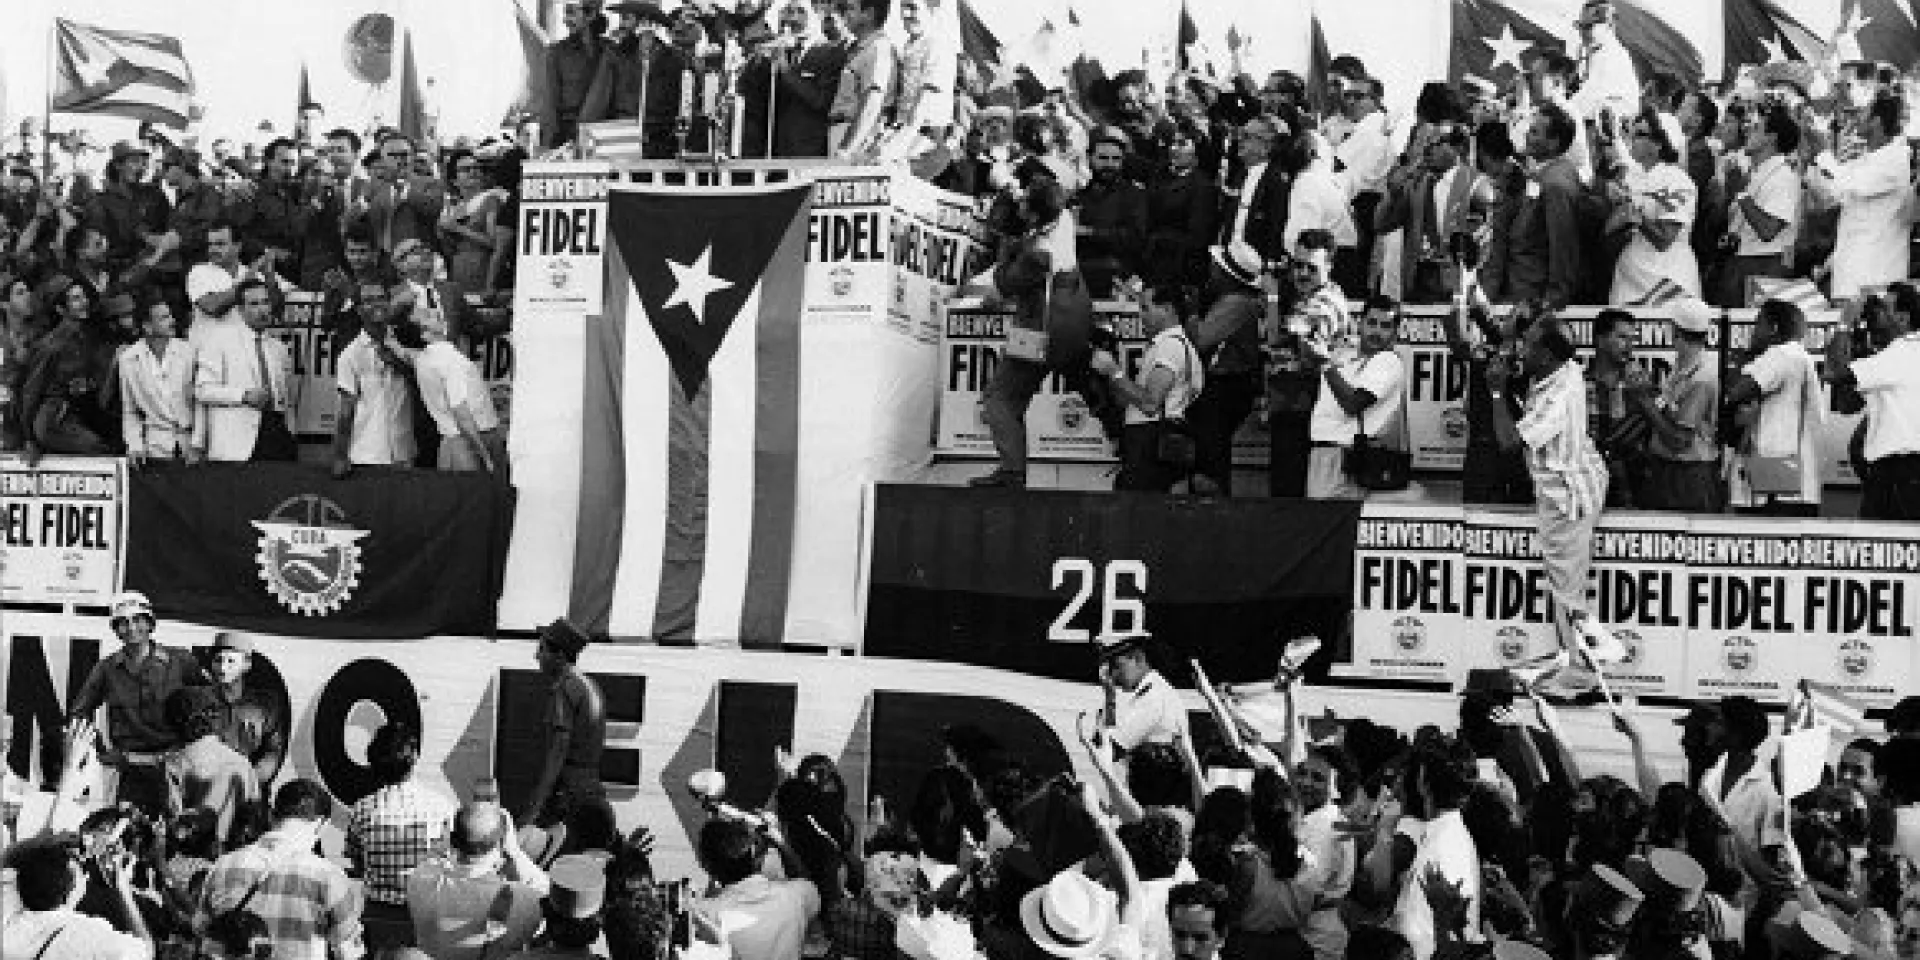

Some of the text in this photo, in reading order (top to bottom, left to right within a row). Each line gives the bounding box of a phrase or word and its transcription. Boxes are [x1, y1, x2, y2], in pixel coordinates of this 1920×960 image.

[522, 207, 600, 255] FIDEL
[804, 212, 886, 262] FIDEL
[0, 503, 34, 548] EL
[40, 503, 110, 550] FIDEL
[1357, 520, 1464, 549] BIENVENIDO
[1687, 534, 1800, 567] BIENVENIDO
[1802, 538, 1920, 569] BIENVENIDO
[1046, 557, 1149, 643] 26
[1361, 556, 1461, 613] FIDEL
[1687, 572, 1795, 633] FIDEL
[1803, 576, 1914, 637] FIDEL
